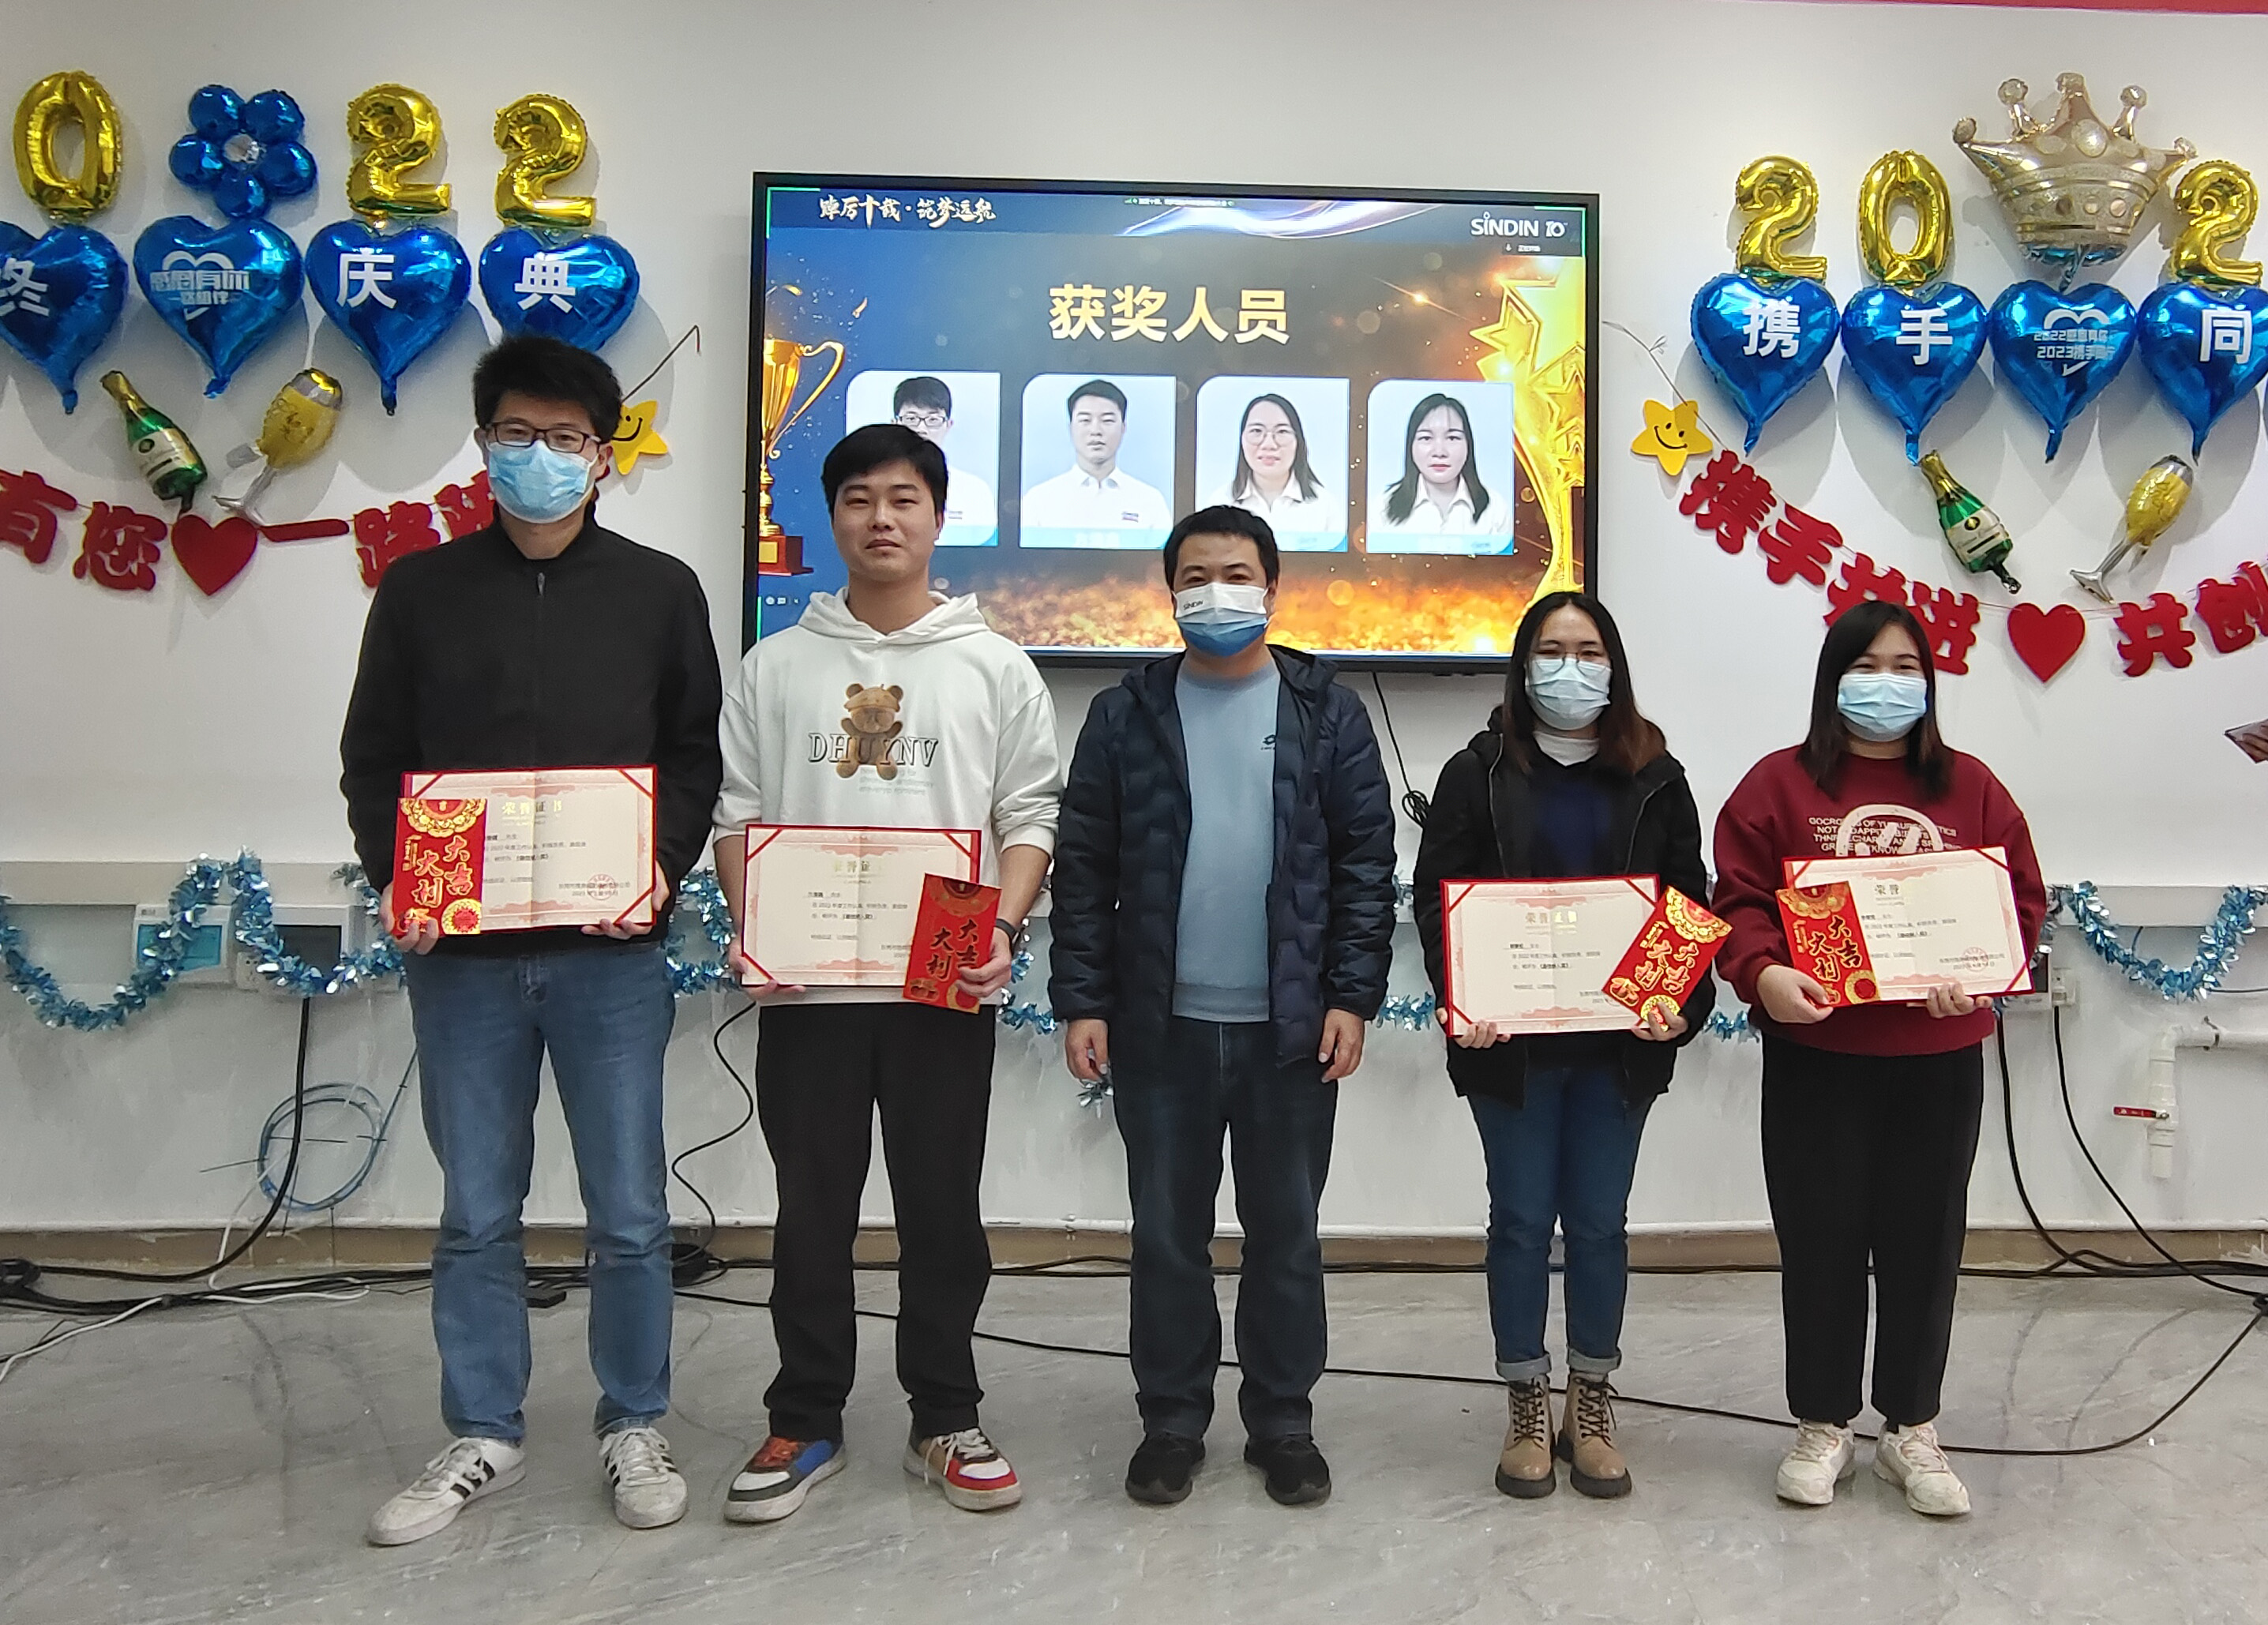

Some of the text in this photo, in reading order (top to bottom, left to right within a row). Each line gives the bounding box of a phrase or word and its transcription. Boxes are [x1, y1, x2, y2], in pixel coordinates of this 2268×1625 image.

[347, 83, 453, 218] 2
[494, 92, 598, 227] 2
[1735, 150, 2264, 285] 2 0 2
[337, 252, 398, 309] 庆
[515, 254, 576, 313] 典
[1049, 283, 1290, 345] 获奖人员
[1742, 304, 2253, 366] 携 手 同
